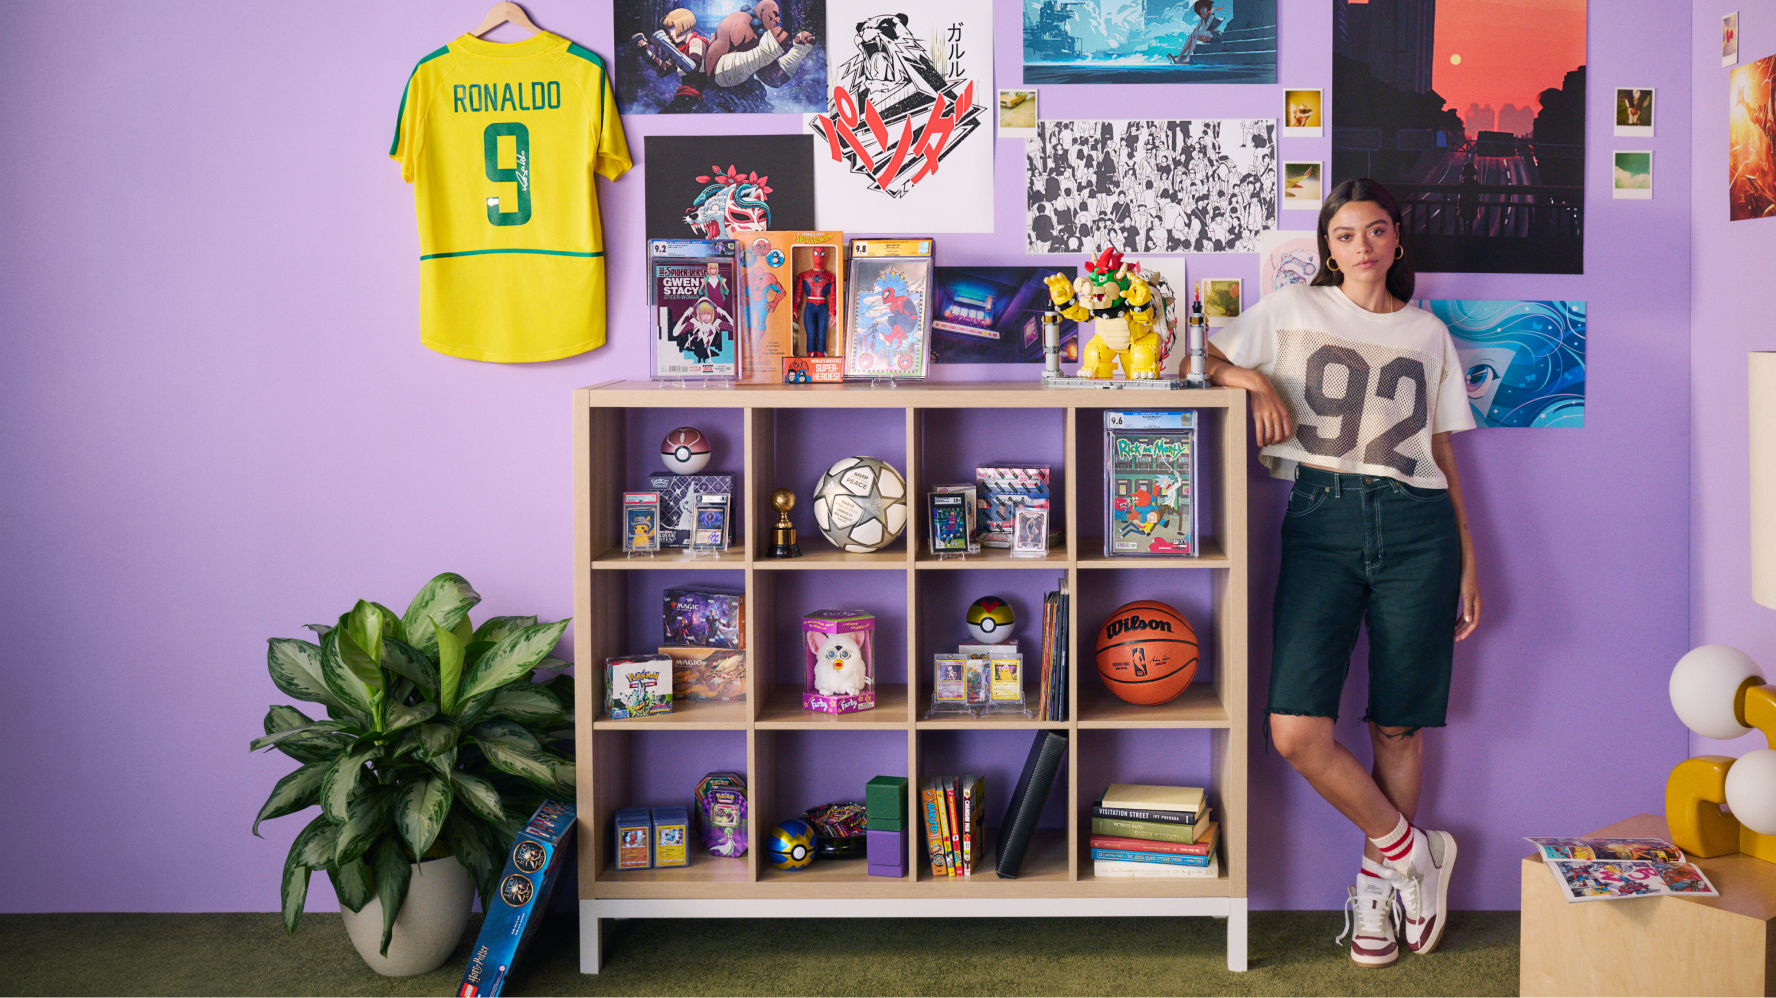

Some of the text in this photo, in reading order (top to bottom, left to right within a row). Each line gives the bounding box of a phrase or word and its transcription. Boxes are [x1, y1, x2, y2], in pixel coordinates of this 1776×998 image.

[947, 21, 965, 78] ガルル
[453, 80, 561, 113] RONALDO
[818, 79, 974, 191] パンダ
[483, 121, 532, 227] 9
[654, 245, 667, 253] 9.2
[855, 245, 867, 253] 9.8
[663, 277, 700, 287] GWEN
[663, 286, 700, 295] STACY
[815, 363, 840, 373] SUPER-
[812, 372, 841, 381] HEROES!
[1296, 344, 1428, 478] 92
[1111, 417, 1123, 425] 9.6
[846, 477, 868, 490] PEACE
[676, 602, 699, 611] MAGIC
[1105, 615, 1173, 640] Wilson
[674, 659, 702, 667] MAGIC
[810, 698, 828, 712] Furby
[841, 698, 858, 711] Furby
[926, 802, 939, 834] NARUTO
[1099, 808, 1128, 817] VISITATION
[1129, 811, 1150, 819] STREET
[472, 944, 490, 966] Potter
